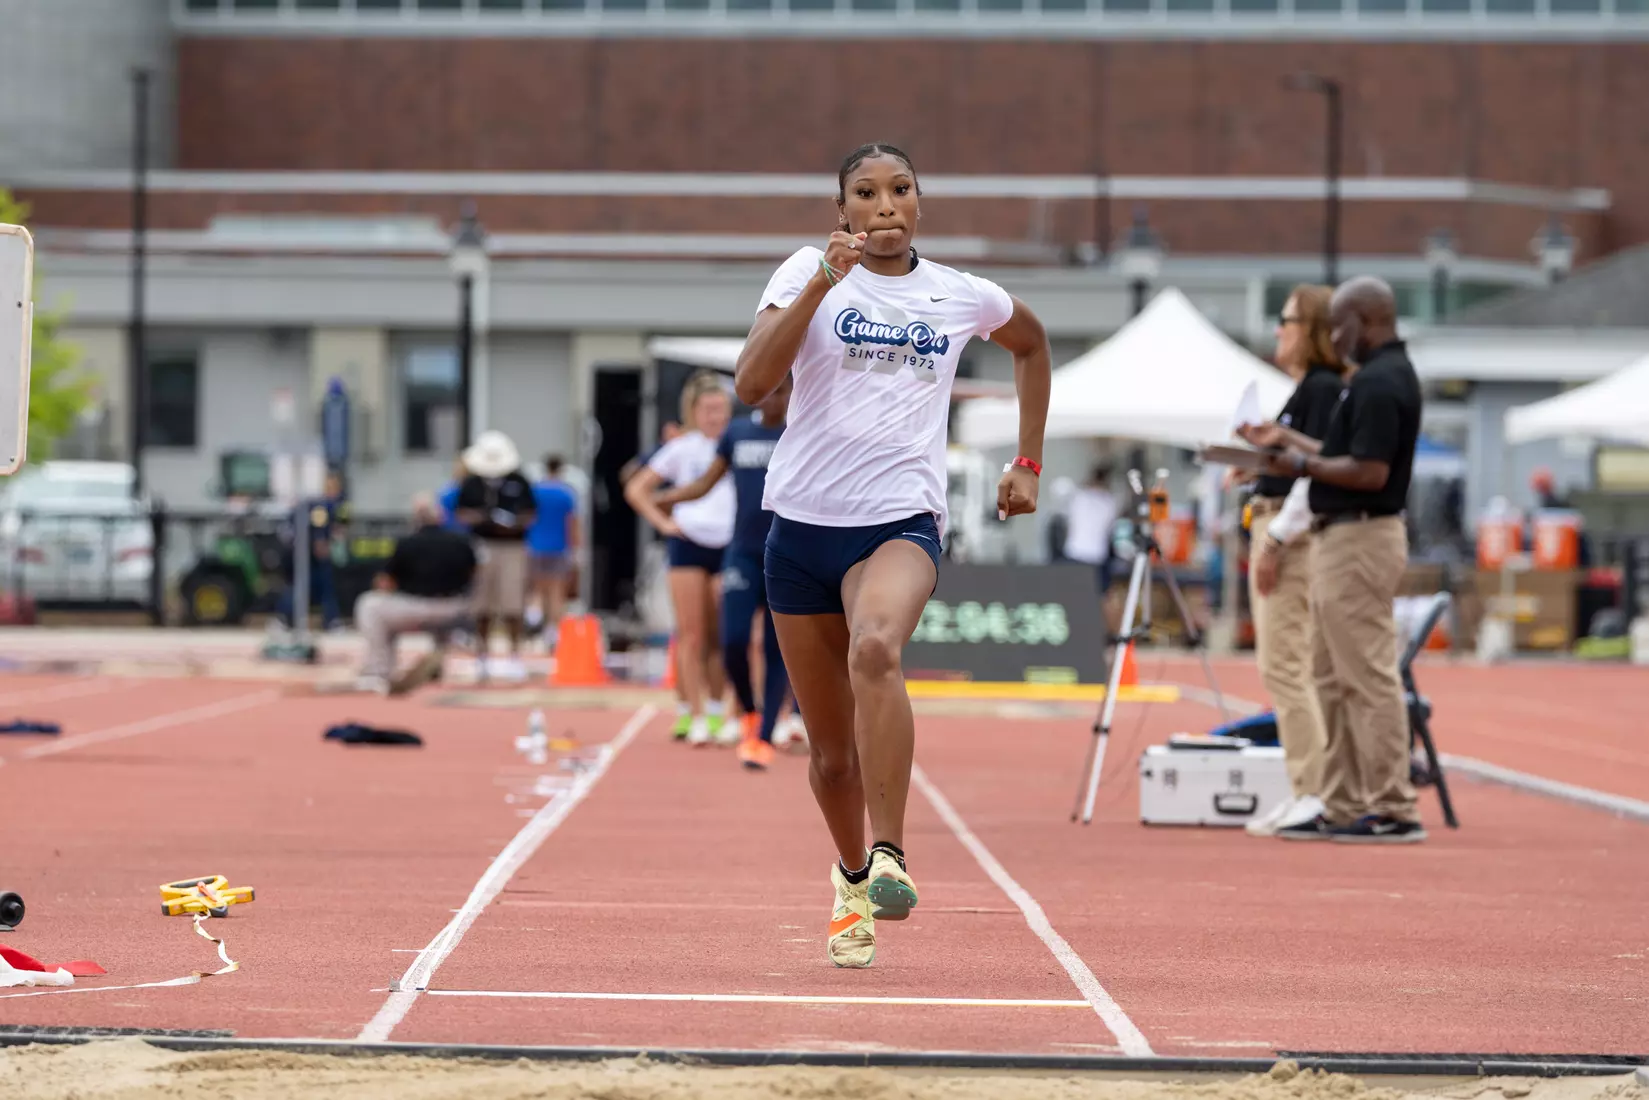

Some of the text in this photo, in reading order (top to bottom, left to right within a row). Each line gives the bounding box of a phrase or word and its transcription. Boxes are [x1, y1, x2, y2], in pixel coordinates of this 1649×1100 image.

[834, 307, 949, 355] Game On
[848, 348, 935, 370] SINCE 1972
